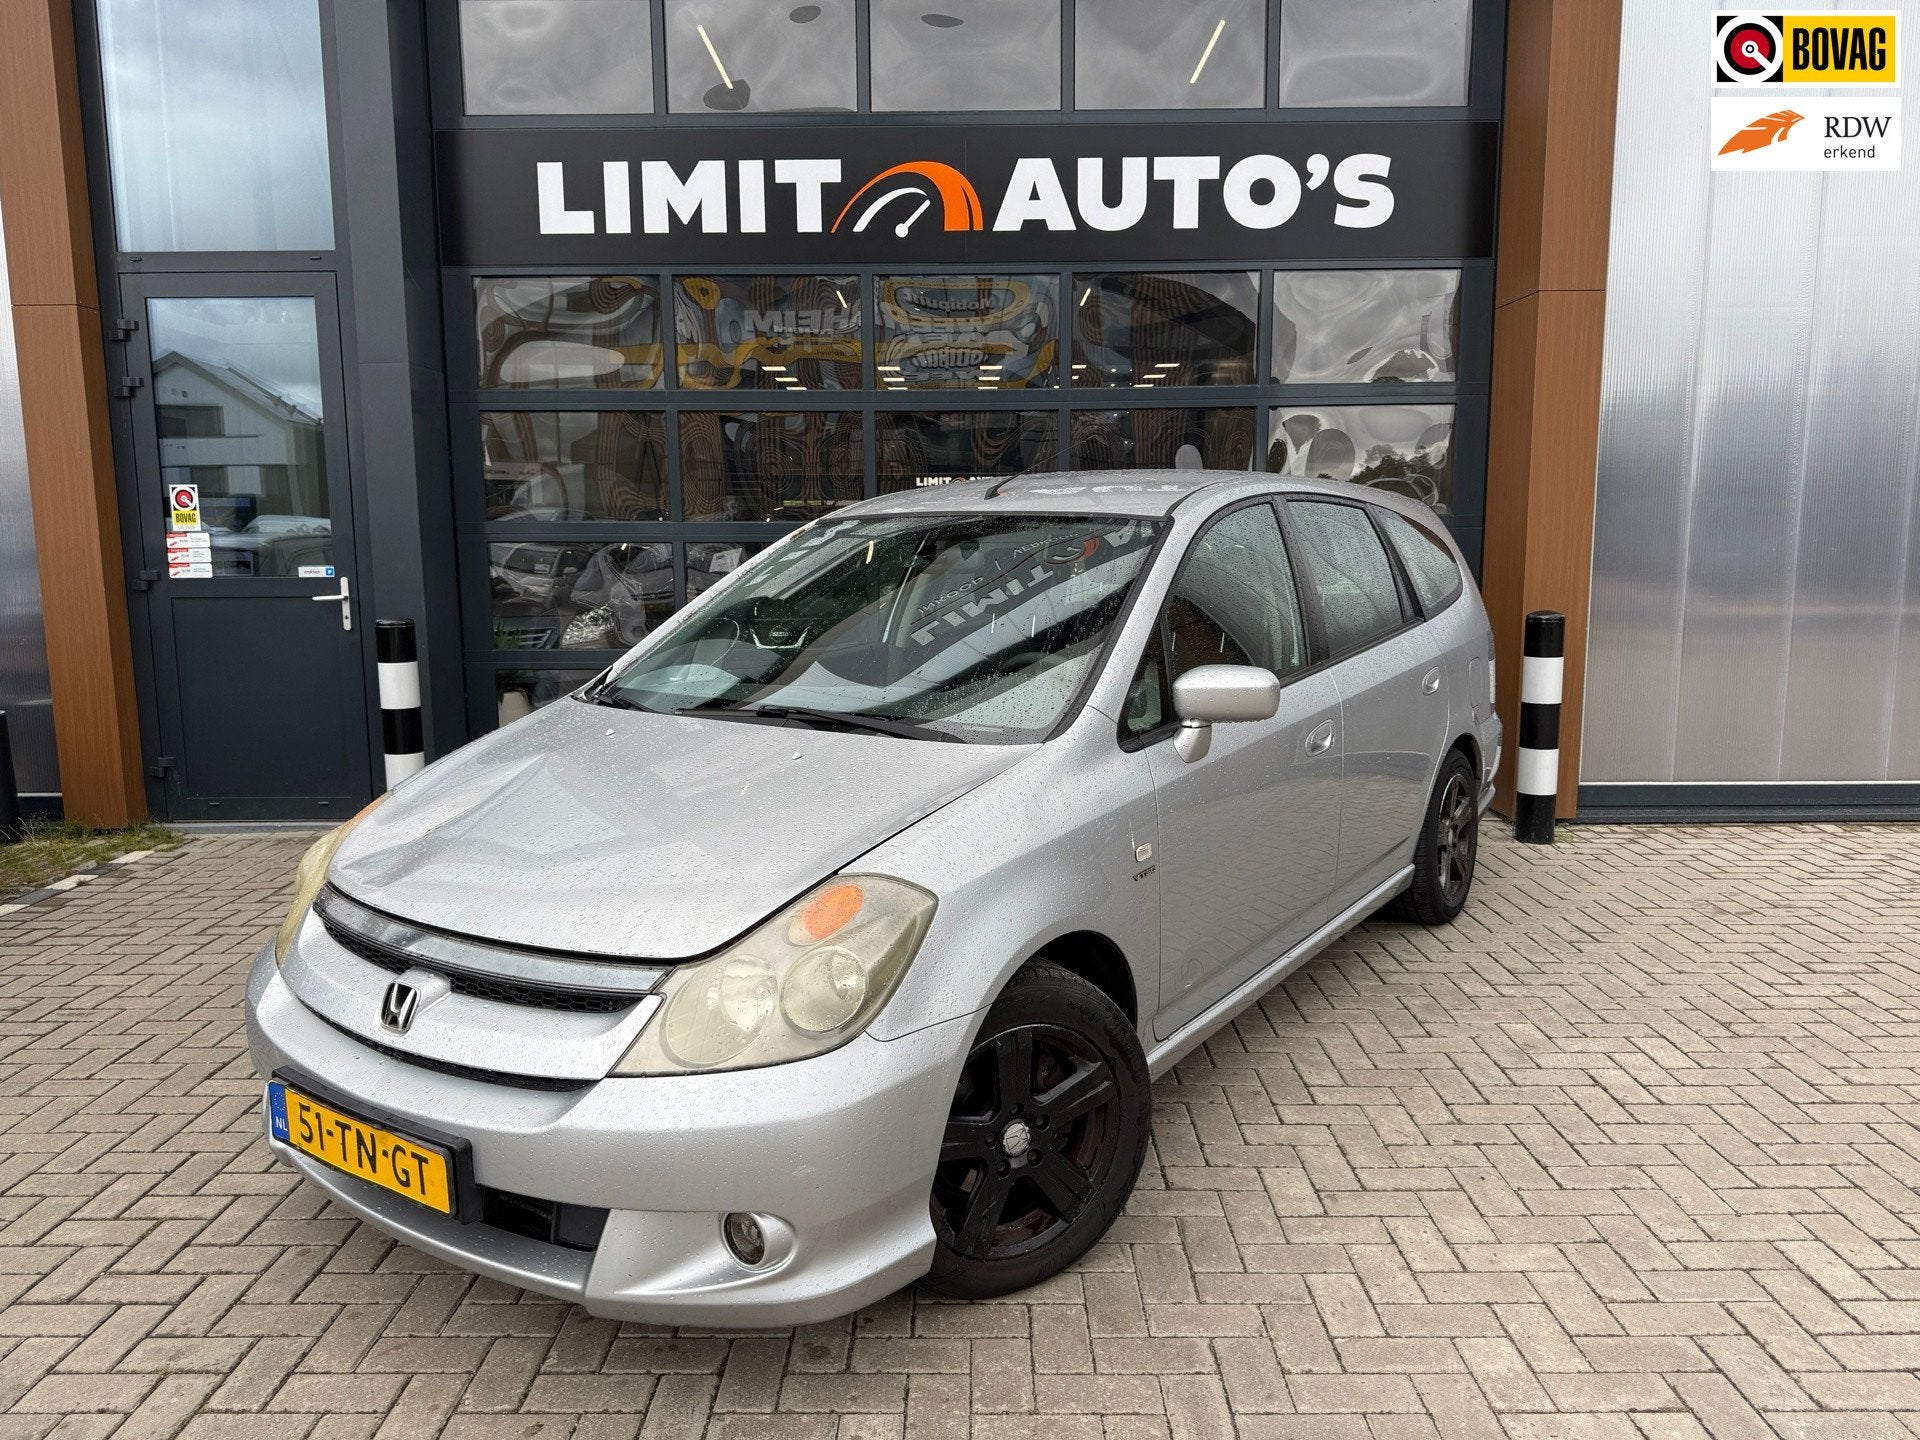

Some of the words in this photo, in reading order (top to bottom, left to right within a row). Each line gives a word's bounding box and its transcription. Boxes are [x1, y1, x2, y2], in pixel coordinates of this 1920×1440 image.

[537, 160, 842, 235] LIMIT
[993, 154, 1395, 232] AUTO'S
[916, 477, 952, 487] LIMIT
[175, 513, 197, 523] BOVAG
[275, 1116, 288, 1132] NL
[298, 1102, 429, 1196] 51-TN-GT
